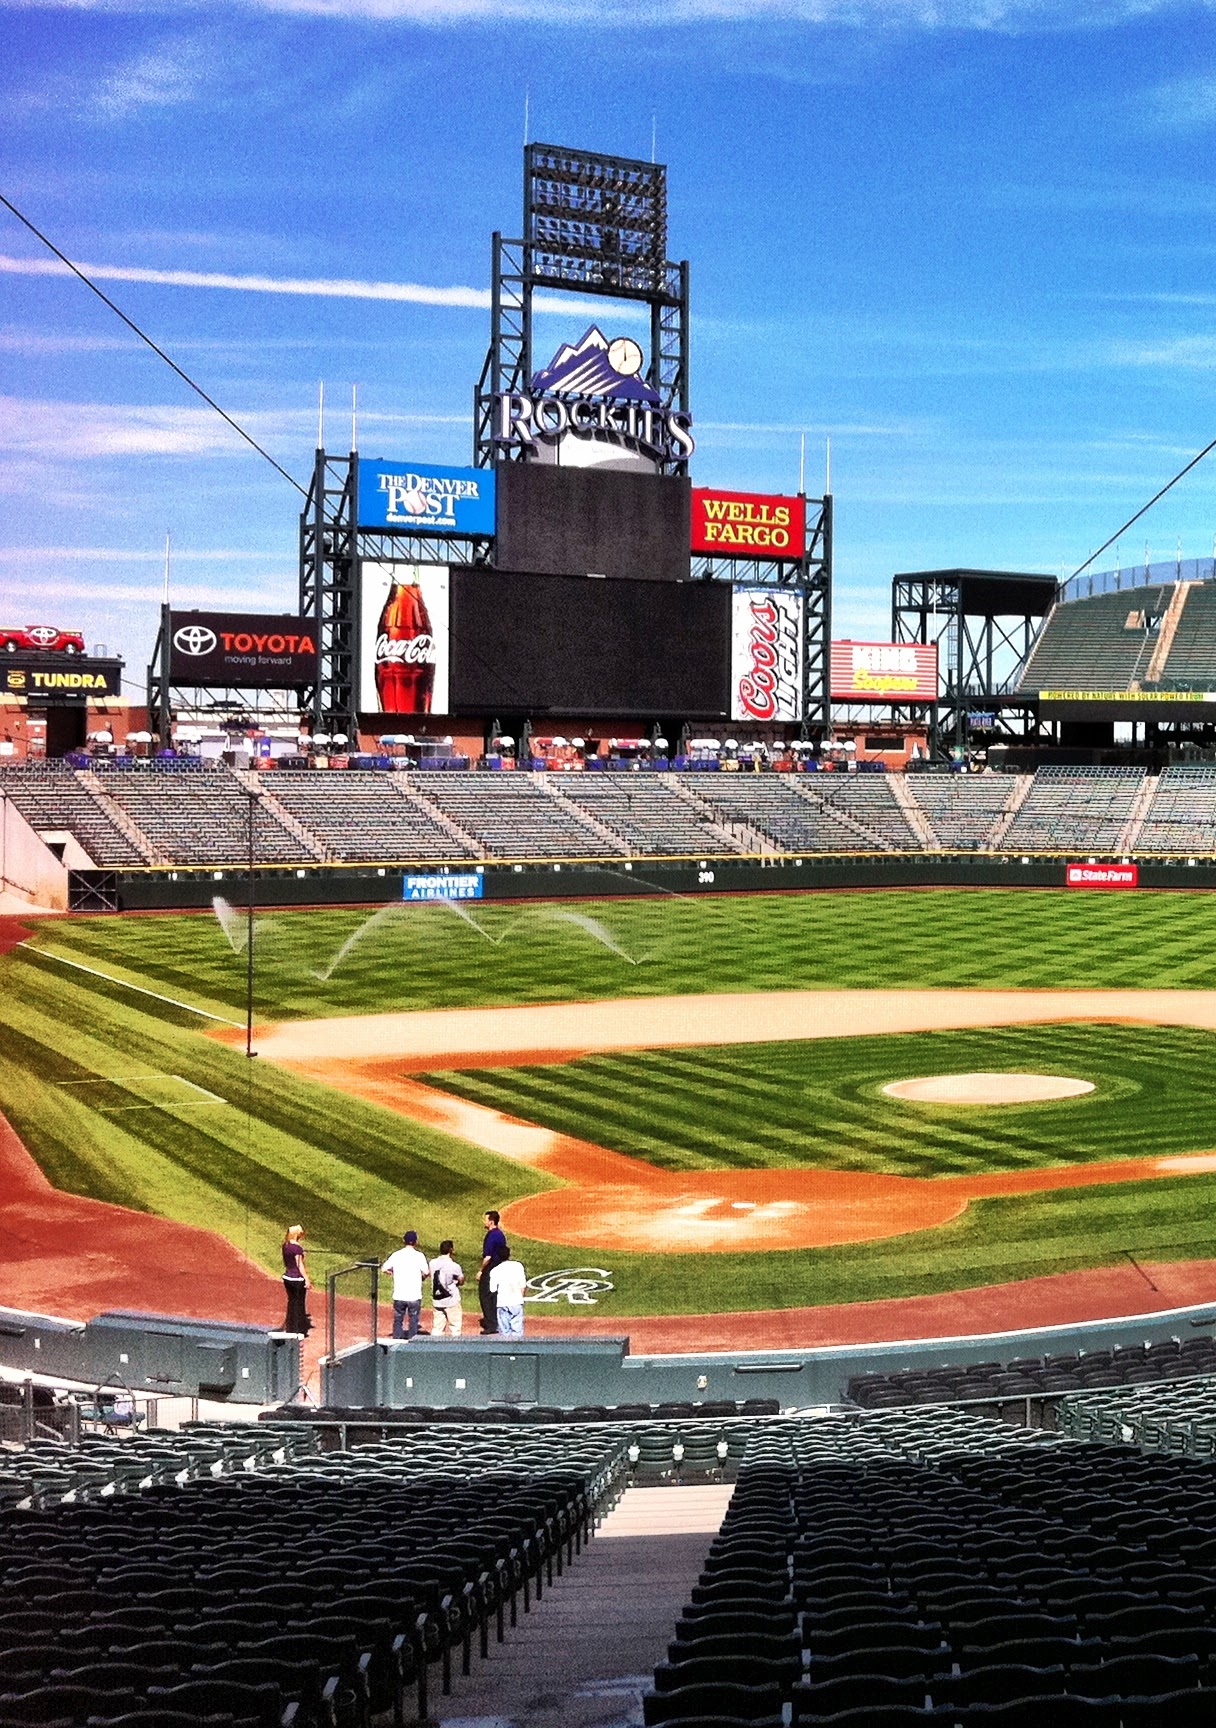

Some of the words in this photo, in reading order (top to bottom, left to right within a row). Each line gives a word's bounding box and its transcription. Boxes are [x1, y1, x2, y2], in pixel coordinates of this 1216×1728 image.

[492, 391, 695, 460] ROCKIES
[377, 473, 406, 489] THE
[406, 473, 479, 496] DENVER
[387, 485, 460, 516] POST
[702, 499, 790, 525] WELLS
[704, 522, 789, 547] FARGO
[220, 632, 316, 654] TOYOTA
[224, 655, 257, 666] moving
[258, 656, 292, 665] forward
[738, 598, 779, 720] Coors
[777, 604, 799, 720] LIGHT
[31, 672, 108, 688] TUNDRA
[407, 876, 479, 889] FRONTIER
[411, 887, 475, 898] AIRLINES
